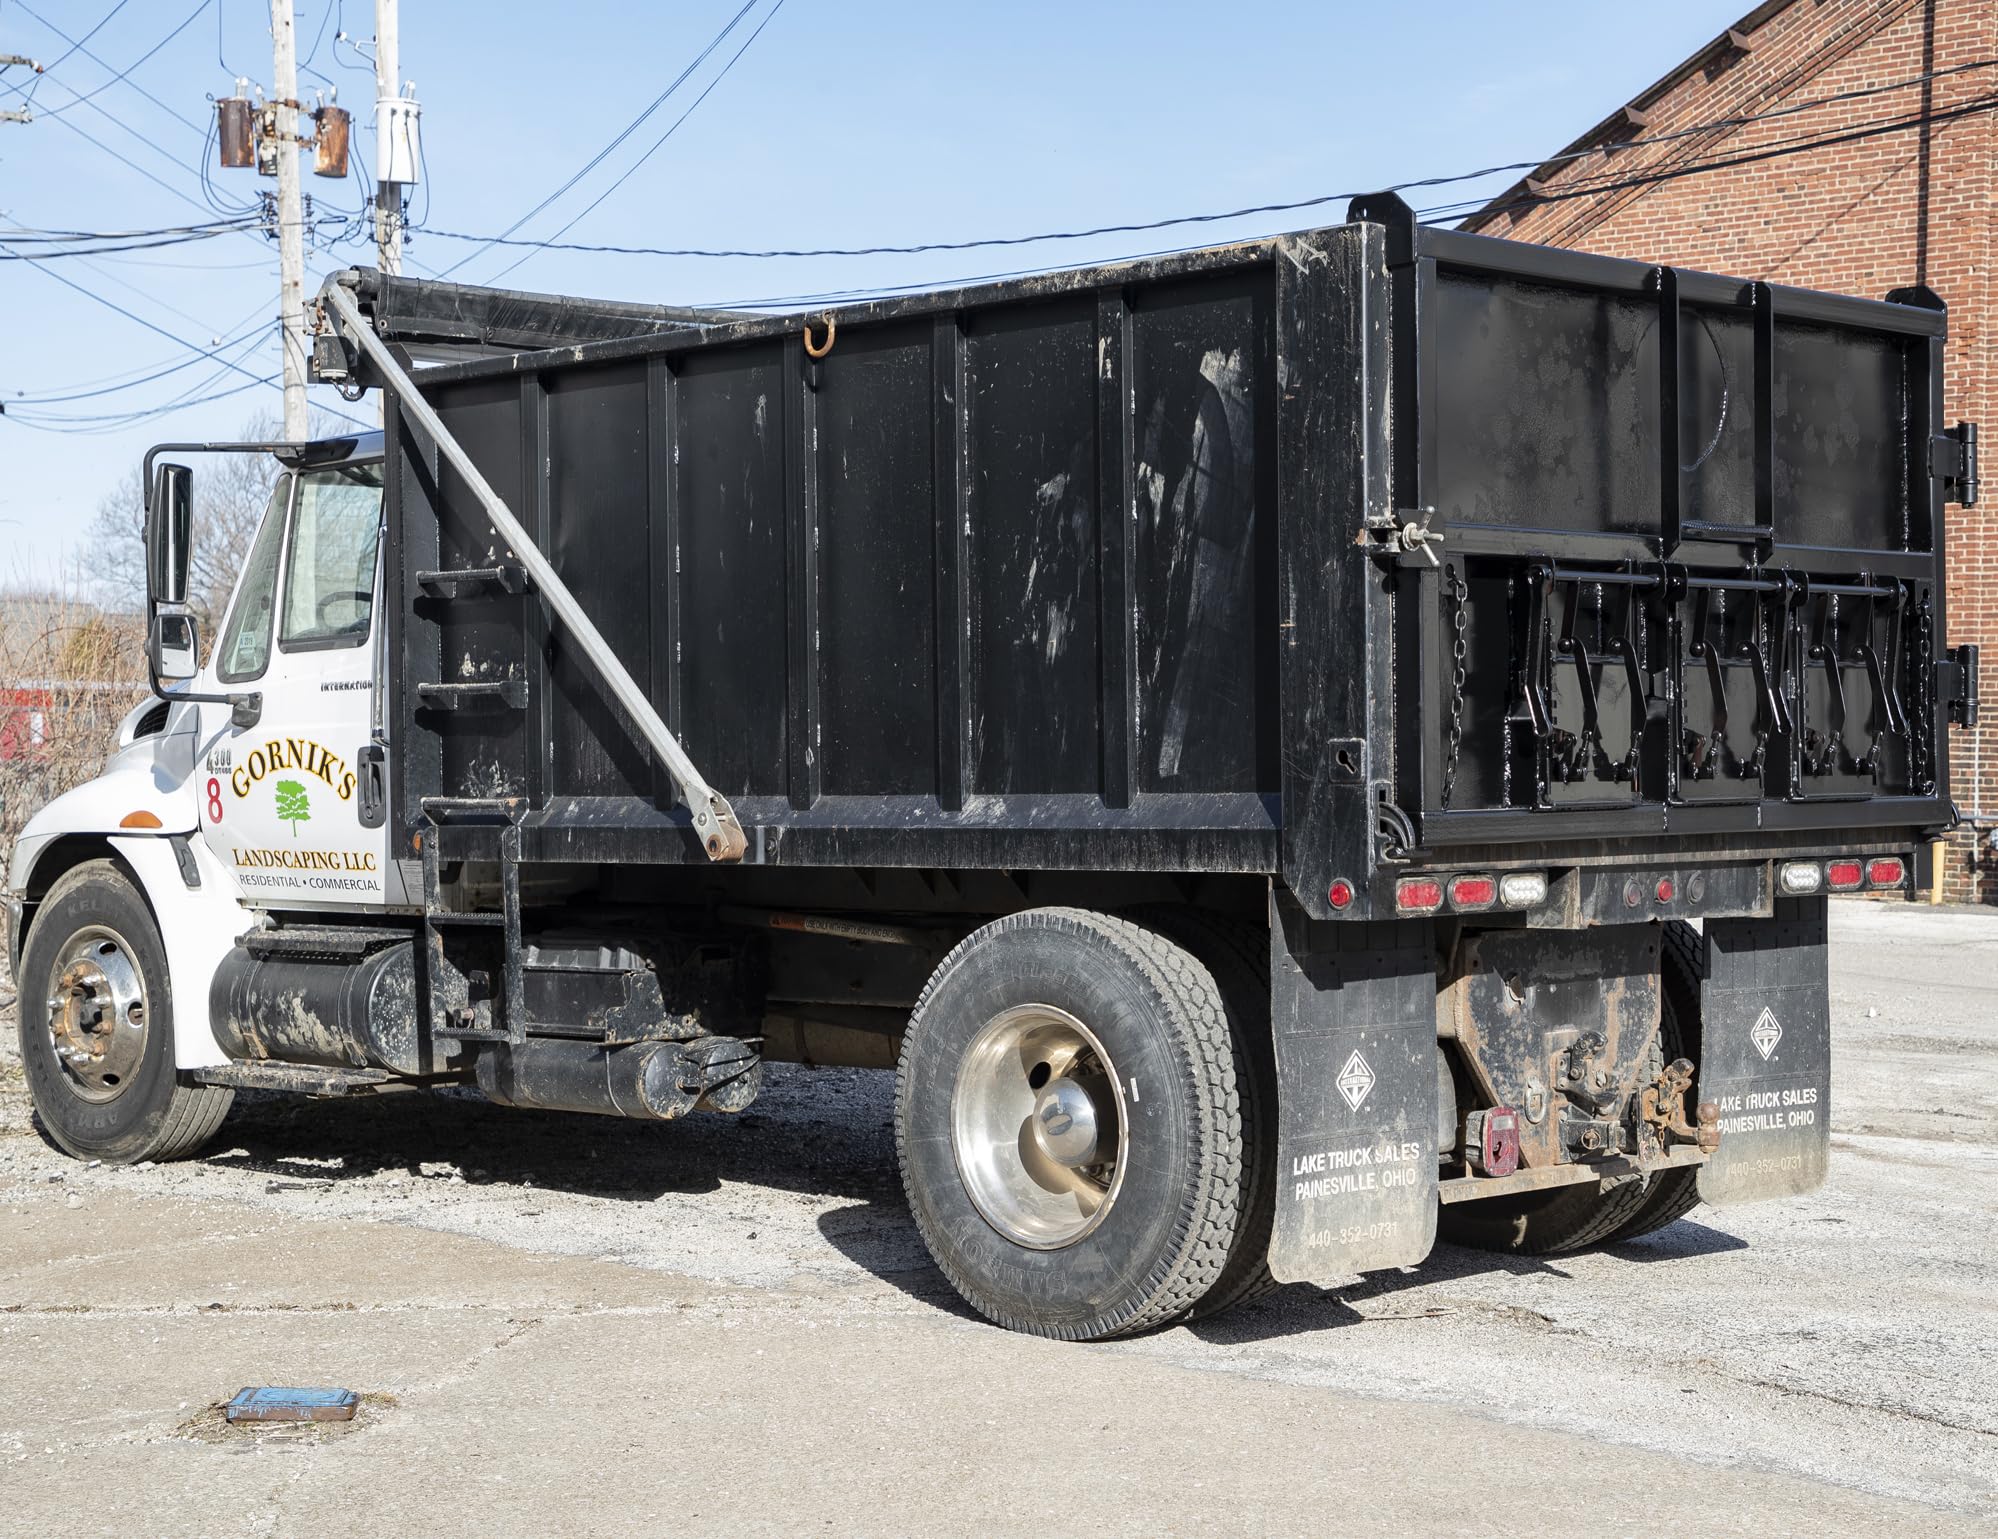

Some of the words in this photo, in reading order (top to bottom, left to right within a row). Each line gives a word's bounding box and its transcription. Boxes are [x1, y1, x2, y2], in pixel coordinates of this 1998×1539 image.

[206, 747, 232, 774] 4300
[231, 738, 357, 801] GORNIK'S
[207, 777, 223, 824] 8
[232, 848, 341, 870] LANDSCAPING
[342, 851, 377, 872] LLC
[239, 874, 301, 888] RESIDENTIAL
[309, 877, 381, 891] COMMERCIAL
[1782, 1088, 1817, 1106] SALES
[1717, 1113, 1786, 1135] PAINESVILLE,
[1788, 1110, 1815, 1127] OHIO
[1293, 1153, 1325, 1176] LAKE
[1328, 1146, 1372, 1170] TRUCK
[1376, 1142, 1420, 1164] SALES
[1729, 1154, 1802, 1177] 440-352-0731
[1295, 1172, 1379, 1201] PAINESVILLE,
[1382, 1168, 1416, 1188] OHIO
[1308, 1221, 1397, 1248] 440-352-0731
